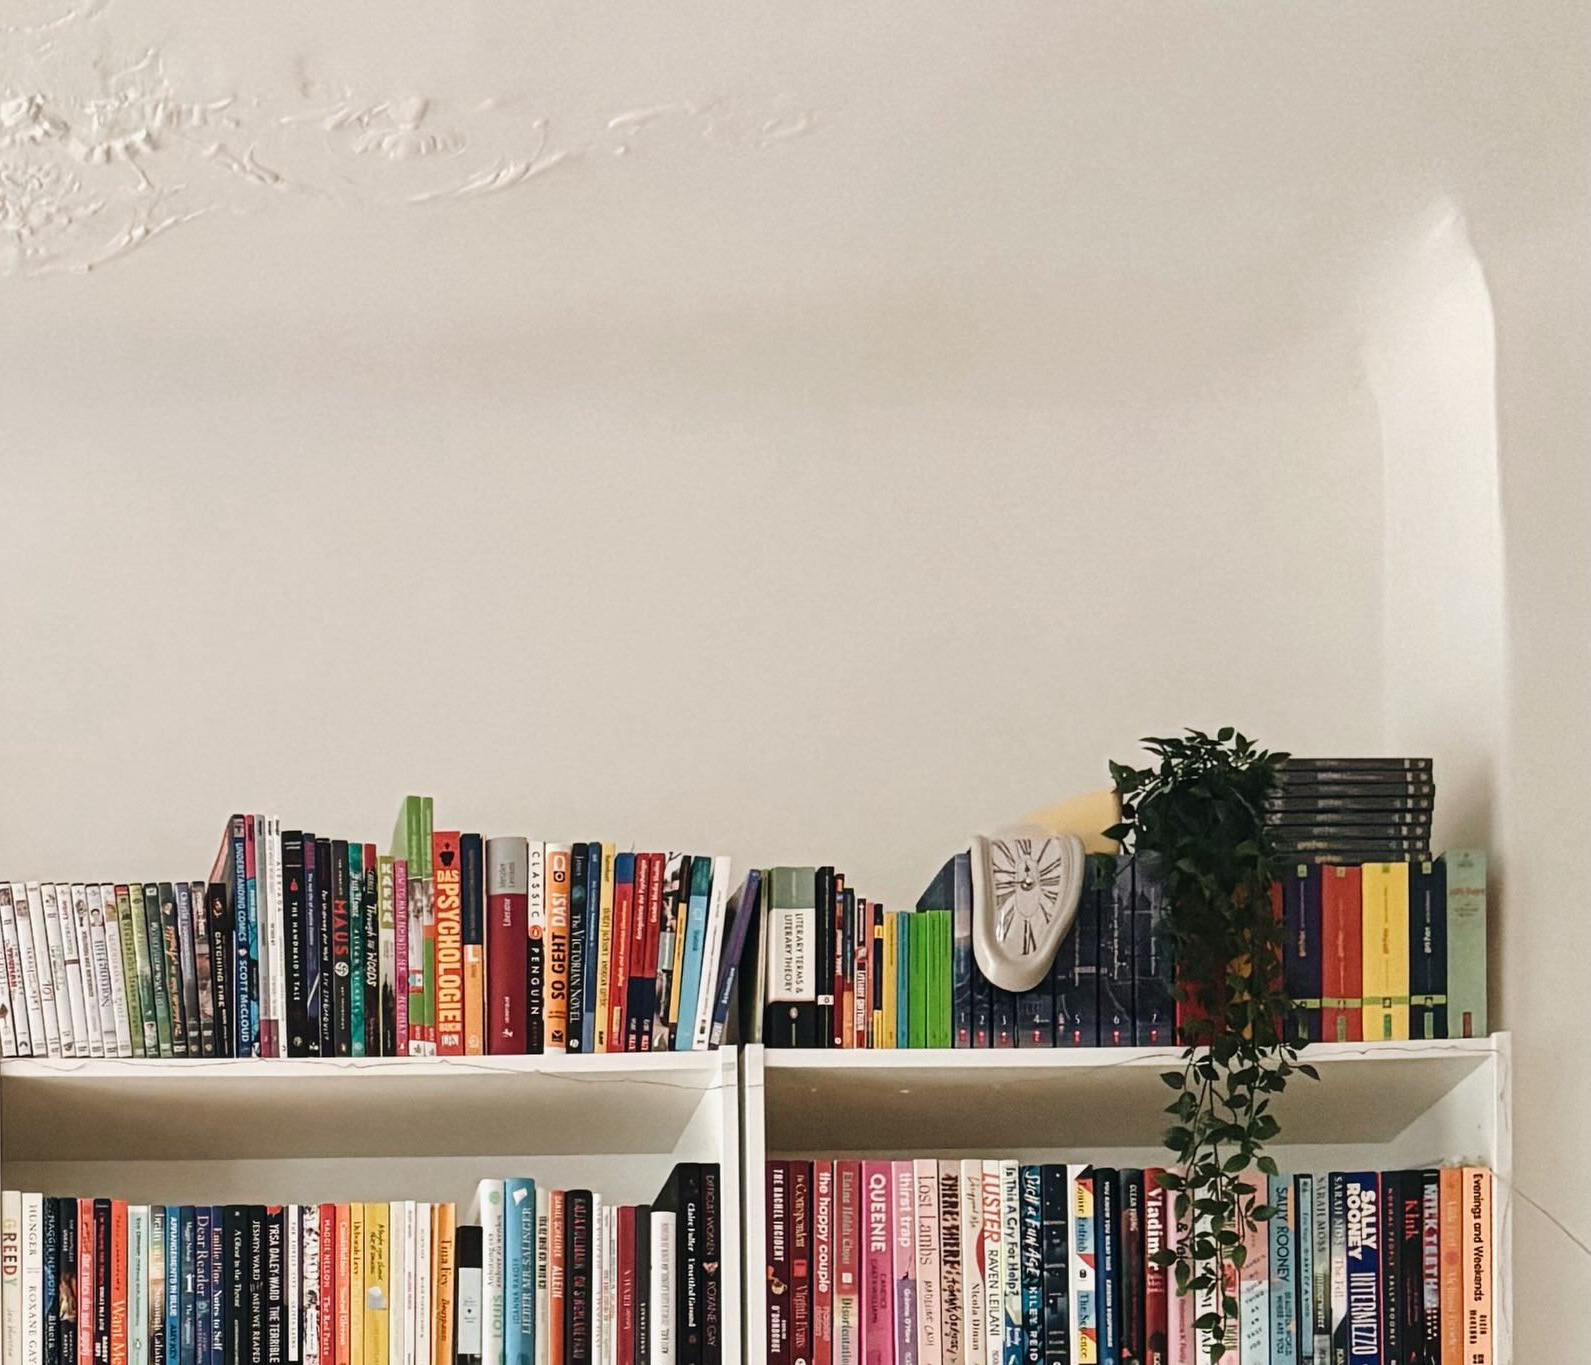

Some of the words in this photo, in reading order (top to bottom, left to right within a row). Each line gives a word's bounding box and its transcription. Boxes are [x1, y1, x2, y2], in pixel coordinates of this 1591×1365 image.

[437, 870, 459, 882] DAS
[532, 851, 540, 917] CLASSIC
[334, 900, 348, 955] MAUS
[436, 883, 462, 1023] PSYCHOLOGIE
[240, 960, 248, 992] SCOTT
[531, 948, 540, 1015] PENGUIN
[240, 994, 250, 1042] McCLOUD
[868, 1174, 887, 1252] QUEENIE
[982, 1173, 1001, 1243] LUSTER
[1347, 1183, 1362, 1259] ROONEY
[1362, 1191, 1376, 1249] SALLY
[989, 1250, 1000, 1288] RAVEN
[990, 1294, 1000, 1336] LEILANI
[1351, 1273, 1377, 1354] INTERMEZZO
